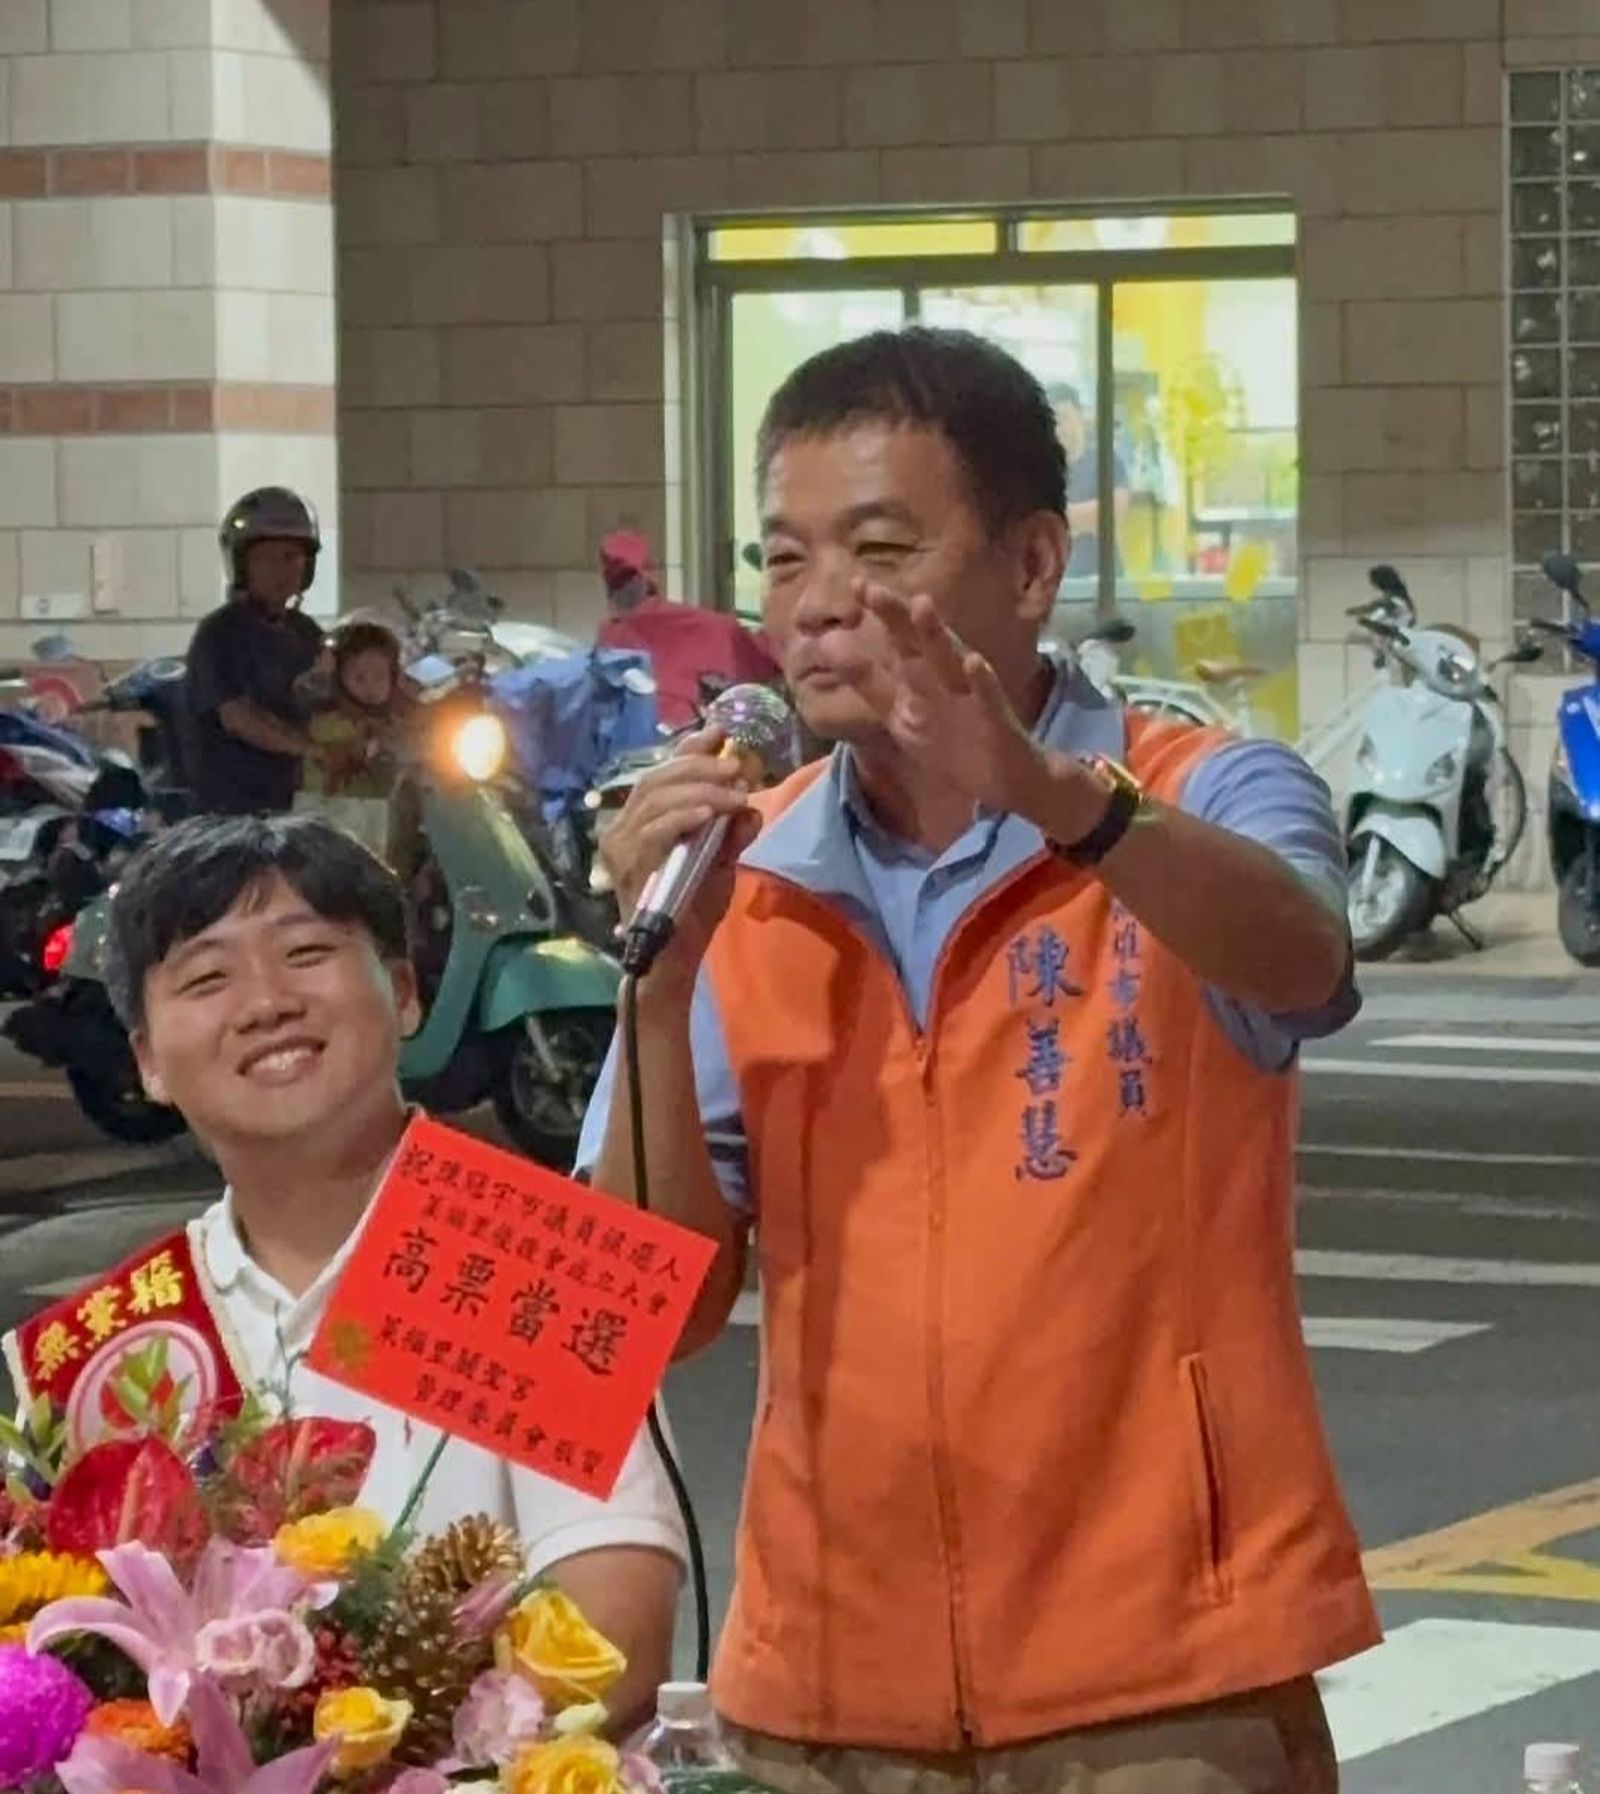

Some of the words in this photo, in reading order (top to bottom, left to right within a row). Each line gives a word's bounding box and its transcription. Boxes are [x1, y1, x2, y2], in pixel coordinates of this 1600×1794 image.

[1006, 925, 1083, 1181] 陳善慧
[1107, 898, 1152, 1117] 雄市議員
[34, 1249, 184, 1381] 無黨籍
[381, 1227, 629, 1377] 高票當選
